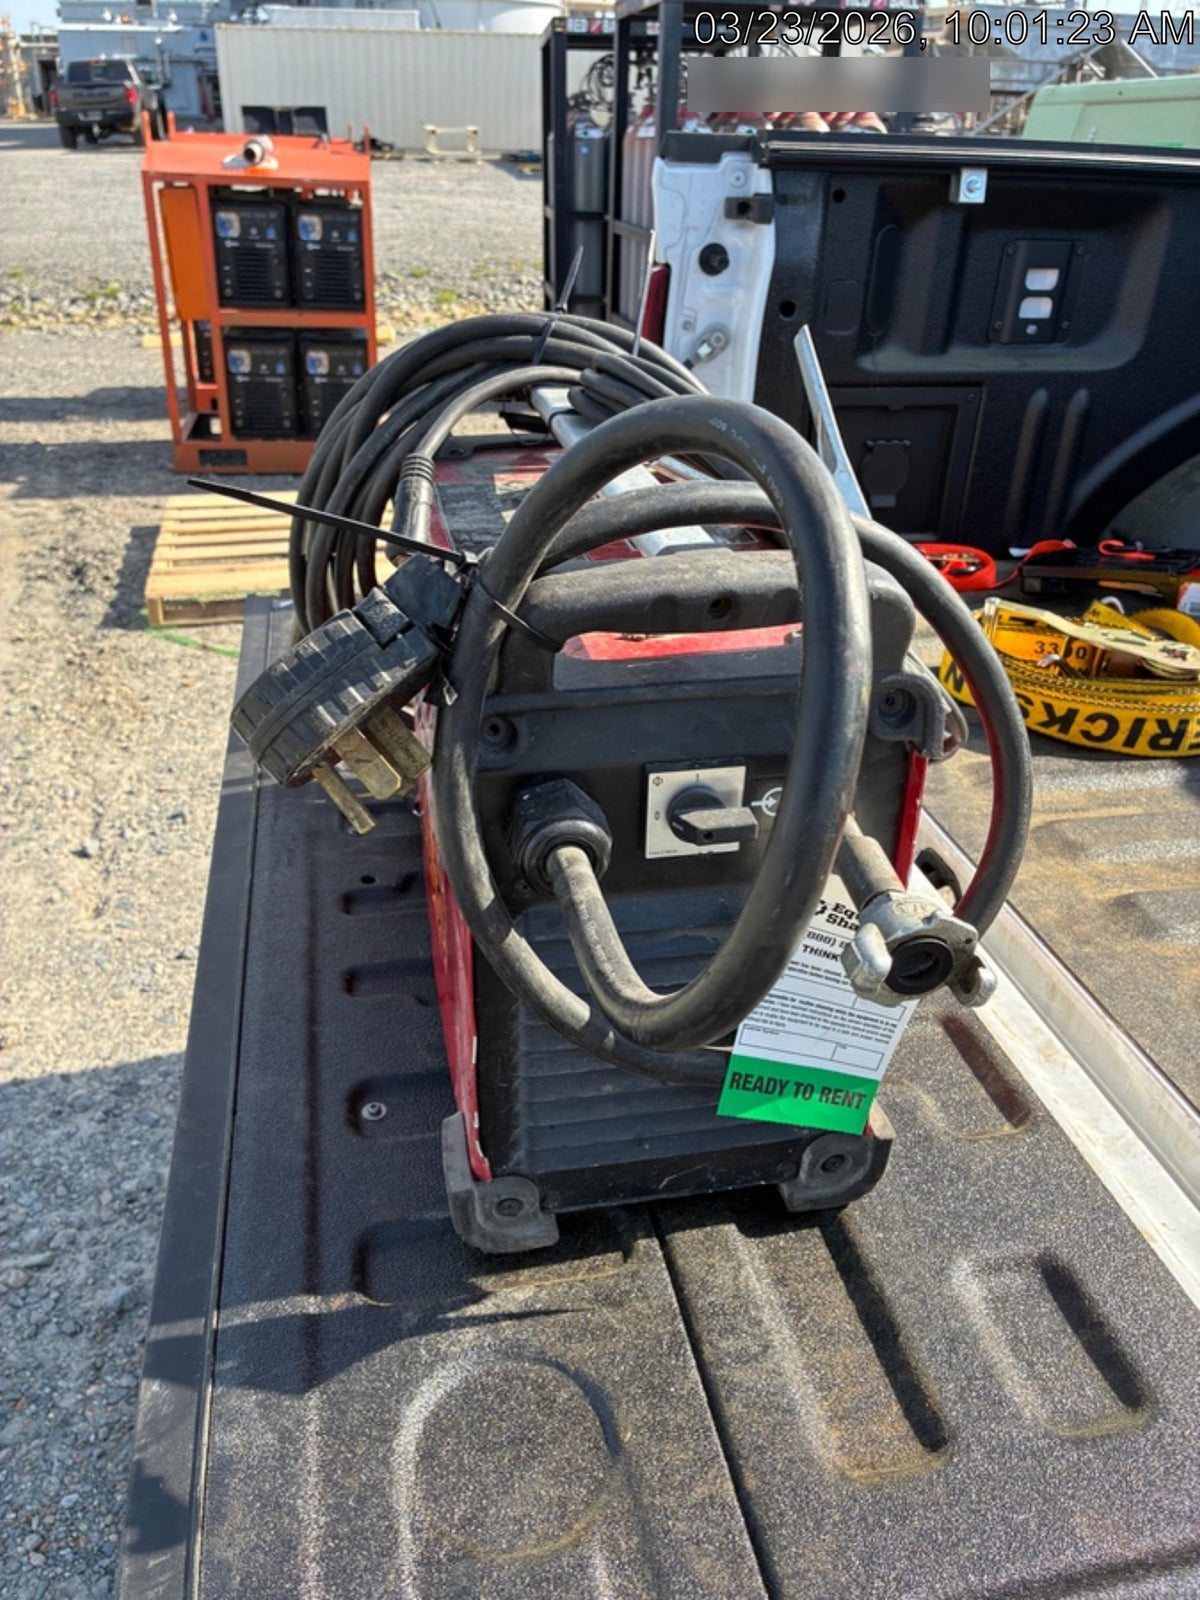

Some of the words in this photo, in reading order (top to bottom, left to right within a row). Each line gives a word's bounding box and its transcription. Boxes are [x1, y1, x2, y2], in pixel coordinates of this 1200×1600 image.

[802, 944, 841, 962] THINK
[728, 1071, 790, 1098] READY
[792, 1081, 815, 1101] TO
[818, 1086, 867, 1110] RENT
